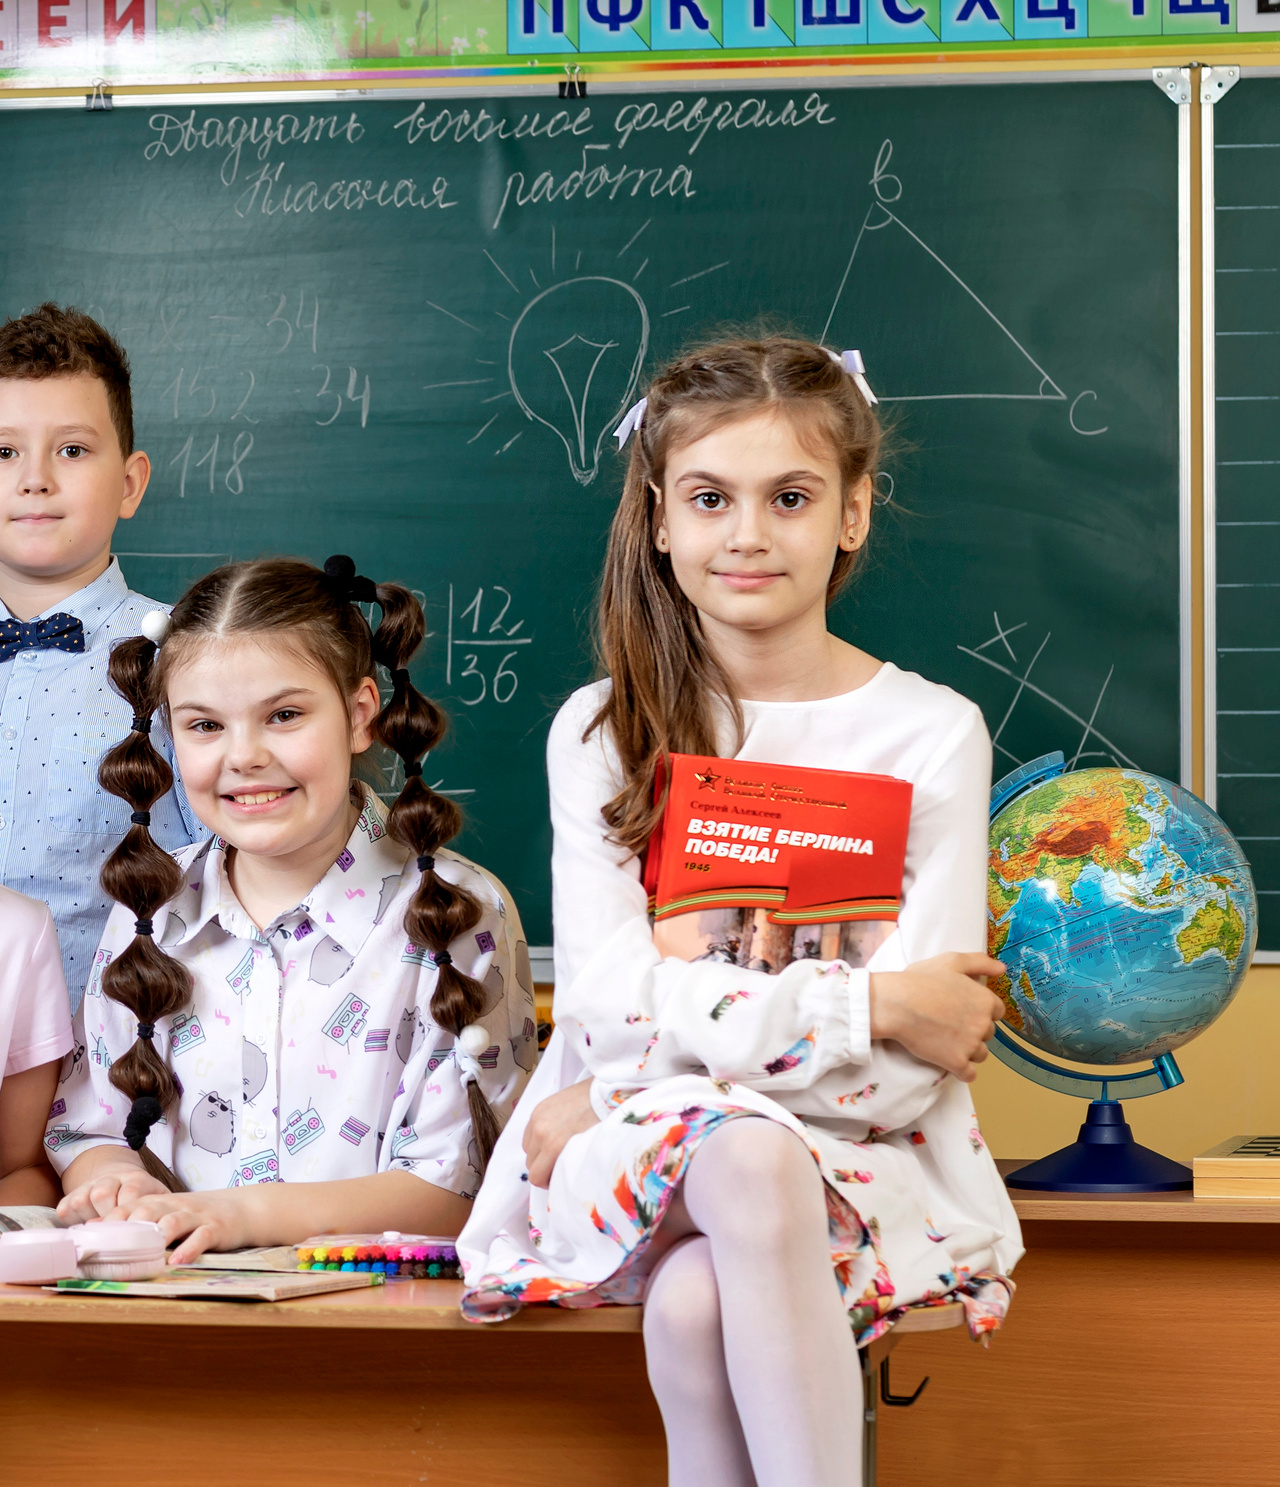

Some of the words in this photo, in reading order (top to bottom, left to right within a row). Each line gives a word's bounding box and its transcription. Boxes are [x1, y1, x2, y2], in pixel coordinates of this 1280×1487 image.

[144, 108, 366, 186] Двадцать
[394, 101, 593, 143] восьмое
[615, 92, 837, 155] февраля
[235, 161, 459, 218] Классная
[493, 143, 697, 230] работа
[460, 585, 525, 637] 12
[459, 651, 519, 706] 36
[690, 800, 729, 814] Сергей
[730, 805, 782, 820] Алексеев
[684, 838, 779, 864] ПОБЕДА!
[687, 818, 772, 843] ВЗЯТИЕ
[774, 829, 874, 856] БЕРЛИНА
[684, 861, 711, 873] 1945
